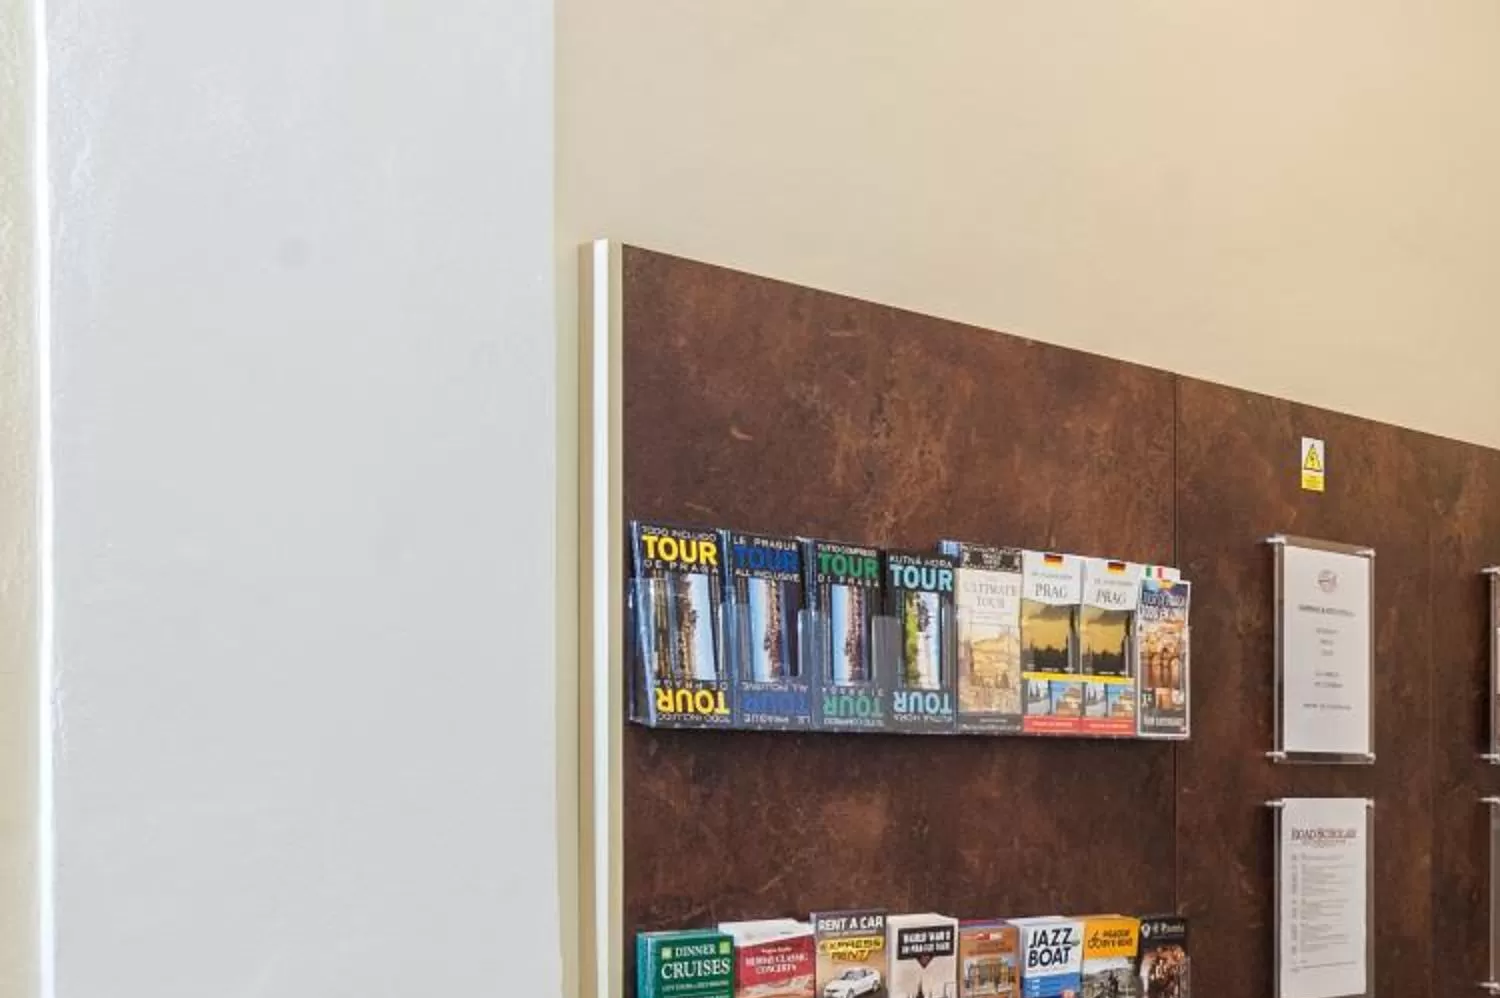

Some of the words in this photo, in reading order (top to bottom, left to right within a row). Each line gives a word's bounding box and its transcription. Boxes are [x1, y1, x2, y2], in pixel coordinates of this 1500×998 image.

[641, 535, 718, 565] TOUR
[754, 538, 798, 551] PRAGUE
[819, 553, 879, 579] TOUR
[889, 564, 953, 591] TOUR
[1035, 583, 1068, 598] PRAG
[655, 688, 730, 715] TOUR
[823, 696, 884, 717] TOUR
[893, 691, 952, 714] TOUR
[819, 918, 847, 931] RENT
[849, 917, 858, 929] A
[860, 915, 884, 929] CAR
[1028, 928, 1073, 948] JAZZ
[675, 943, 716, 957] DINNER
[1028, 947, 1072, 967] BOAT
[661, 958, 731, 979] CRUISES
